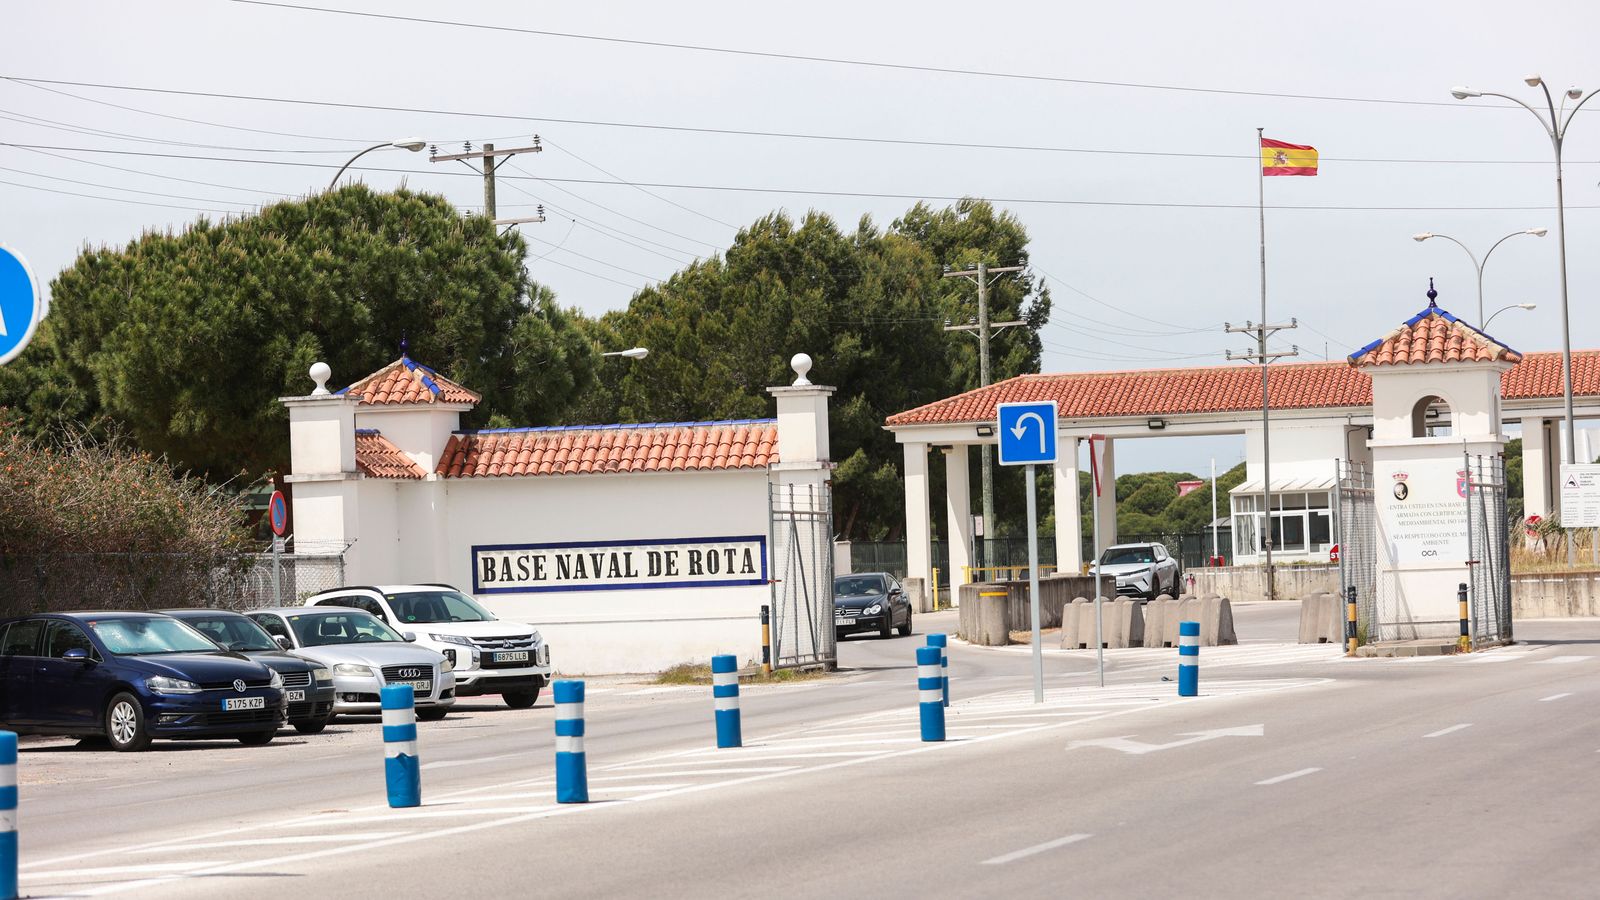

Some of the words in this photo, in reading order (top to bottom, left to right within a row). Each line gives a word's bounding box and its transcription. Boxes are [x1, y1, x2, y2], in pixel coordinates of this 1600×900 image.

[481, 555, 547, 582] BASE
[555, 552, 638, 580] NAVAL
[647, 550, 679, 577] DE
[688, 548, 756, 575] ROTA
[497, 653, 513, 661] 6875
[514, 652, 527, 660] LLB
[416, 681, 429, 689] GRJ
[227, 699, 247, 709] 5175
[248, 698, 262, 708] KZP
